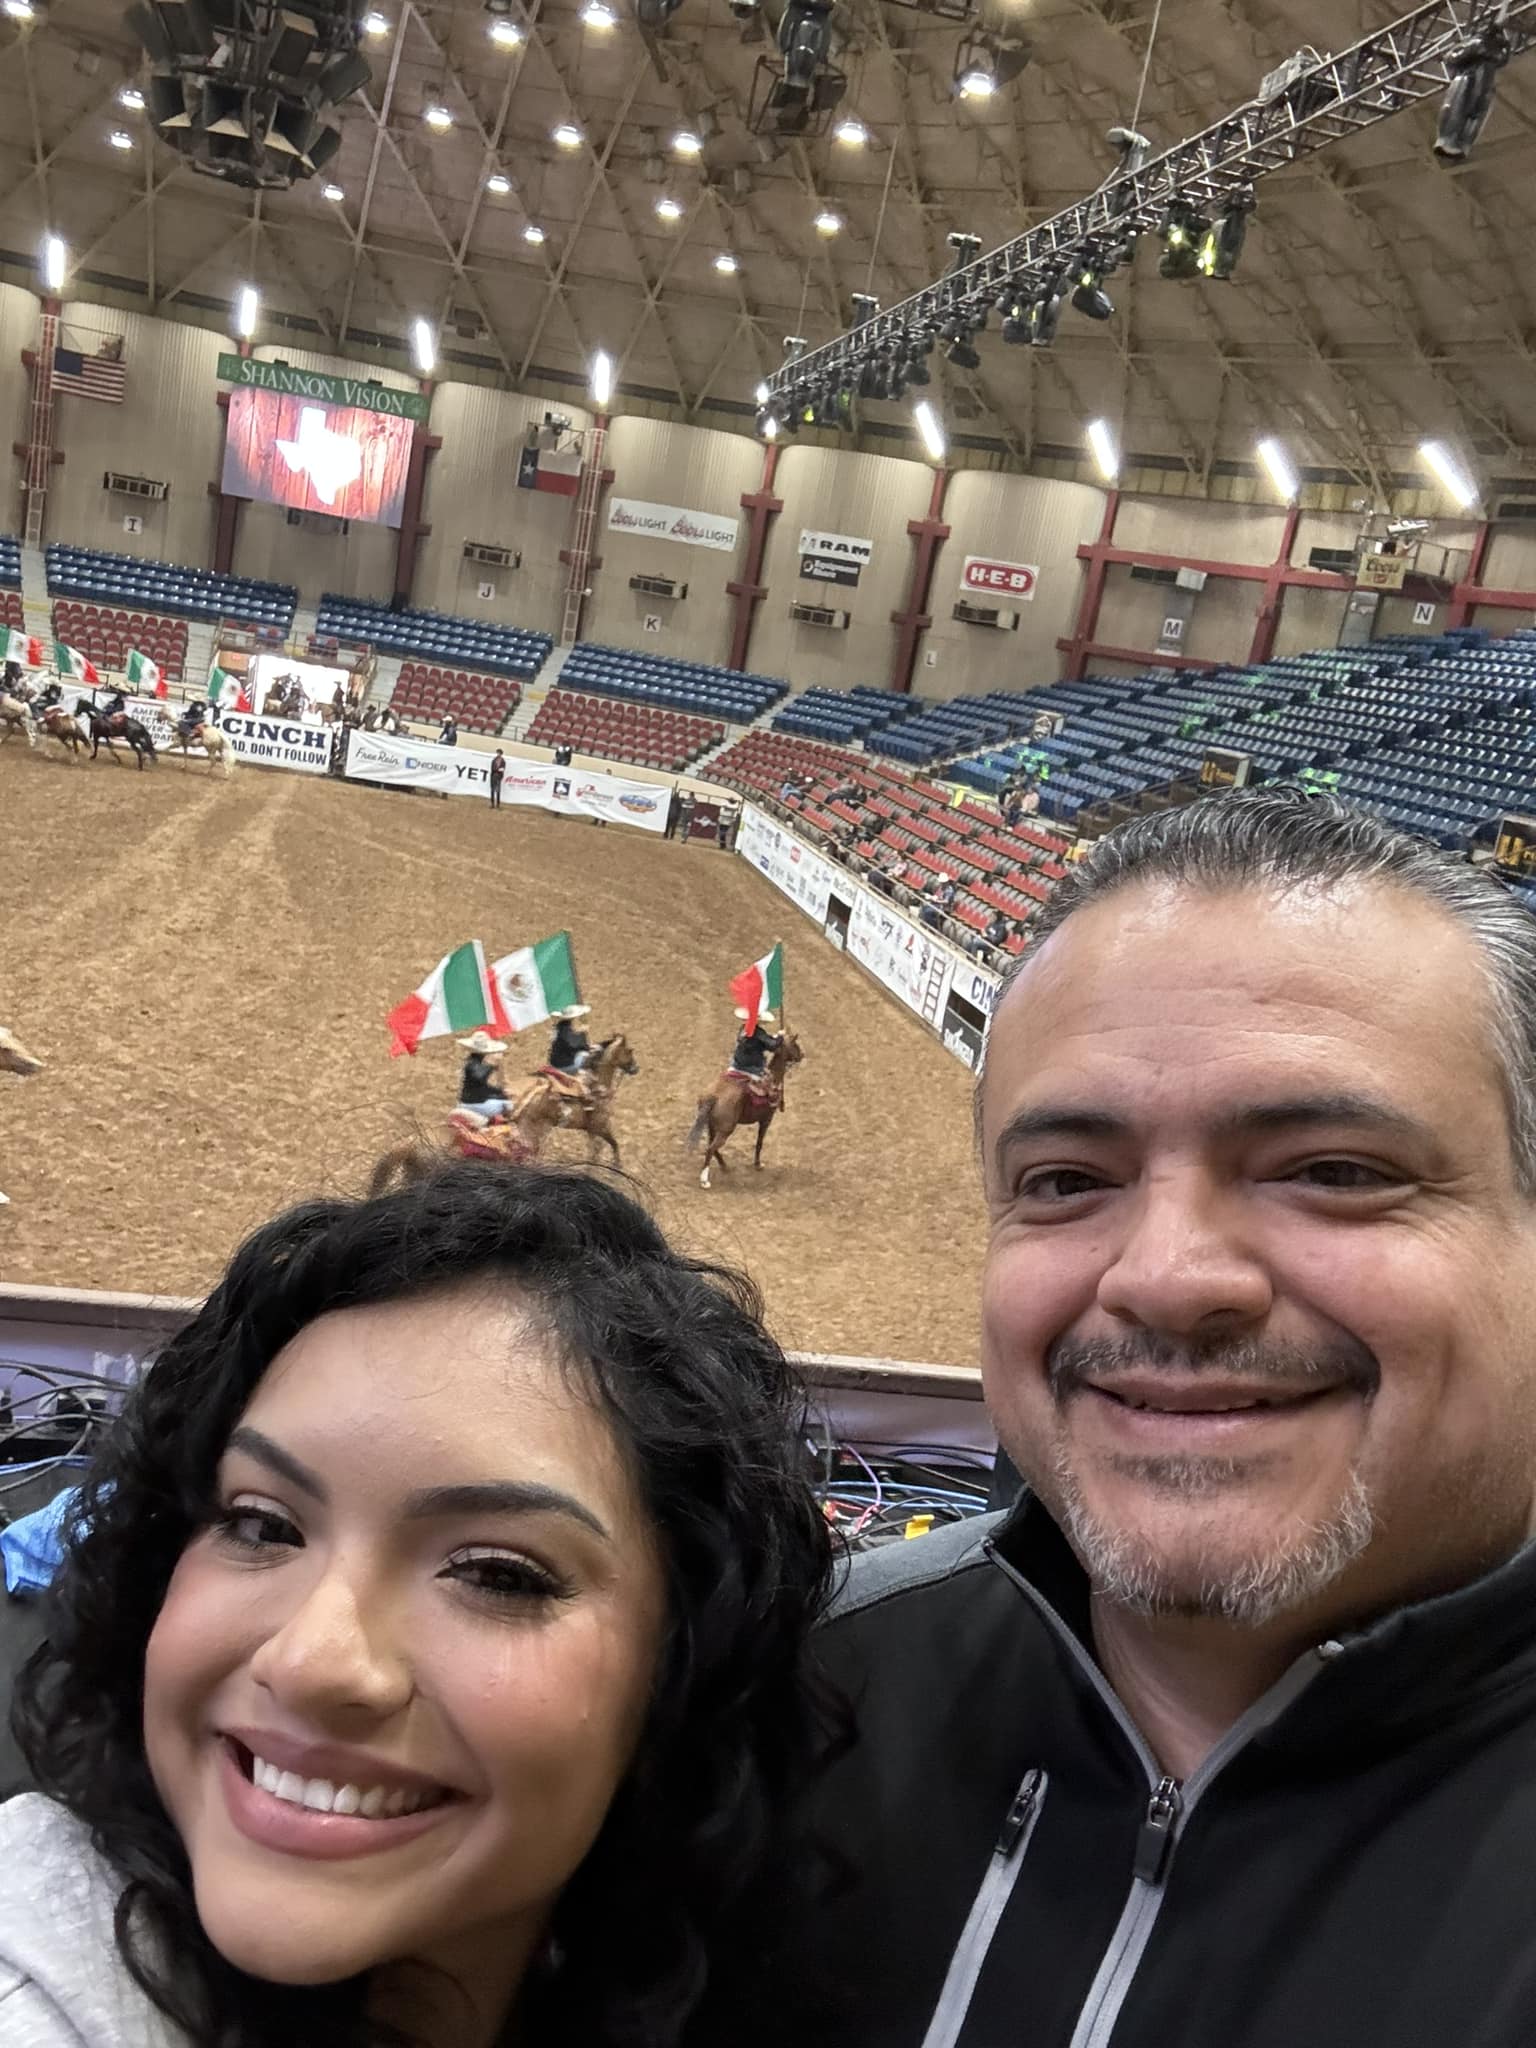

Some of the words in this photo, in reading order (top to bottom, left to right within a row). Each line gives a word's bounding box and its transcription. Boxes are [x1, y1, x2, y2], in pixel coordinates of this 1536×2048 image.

[240, 359, 336, 400] SHANNON
[342, 380, 406, 414] VISION
[638, 517, 667, 530] LIGHT
[705, 529, 735, 543] LIGHT
[820, 540, 870, 556] RAM
[481, 586, 491, 598] J
[1416, 604, 1432, 621] N
[646, 617, 658, 631] K
[1165, 621, 1179, 635] M
[222, 717, 327, 749] CINCH
[250, 742, 282, 760] DON'T
[284, 749, 328, 766] FOLLOW
[355, 747, 377, 760] Free
[379, 751, 399, 765] Rein
[455, 764, 490, 783] YET
